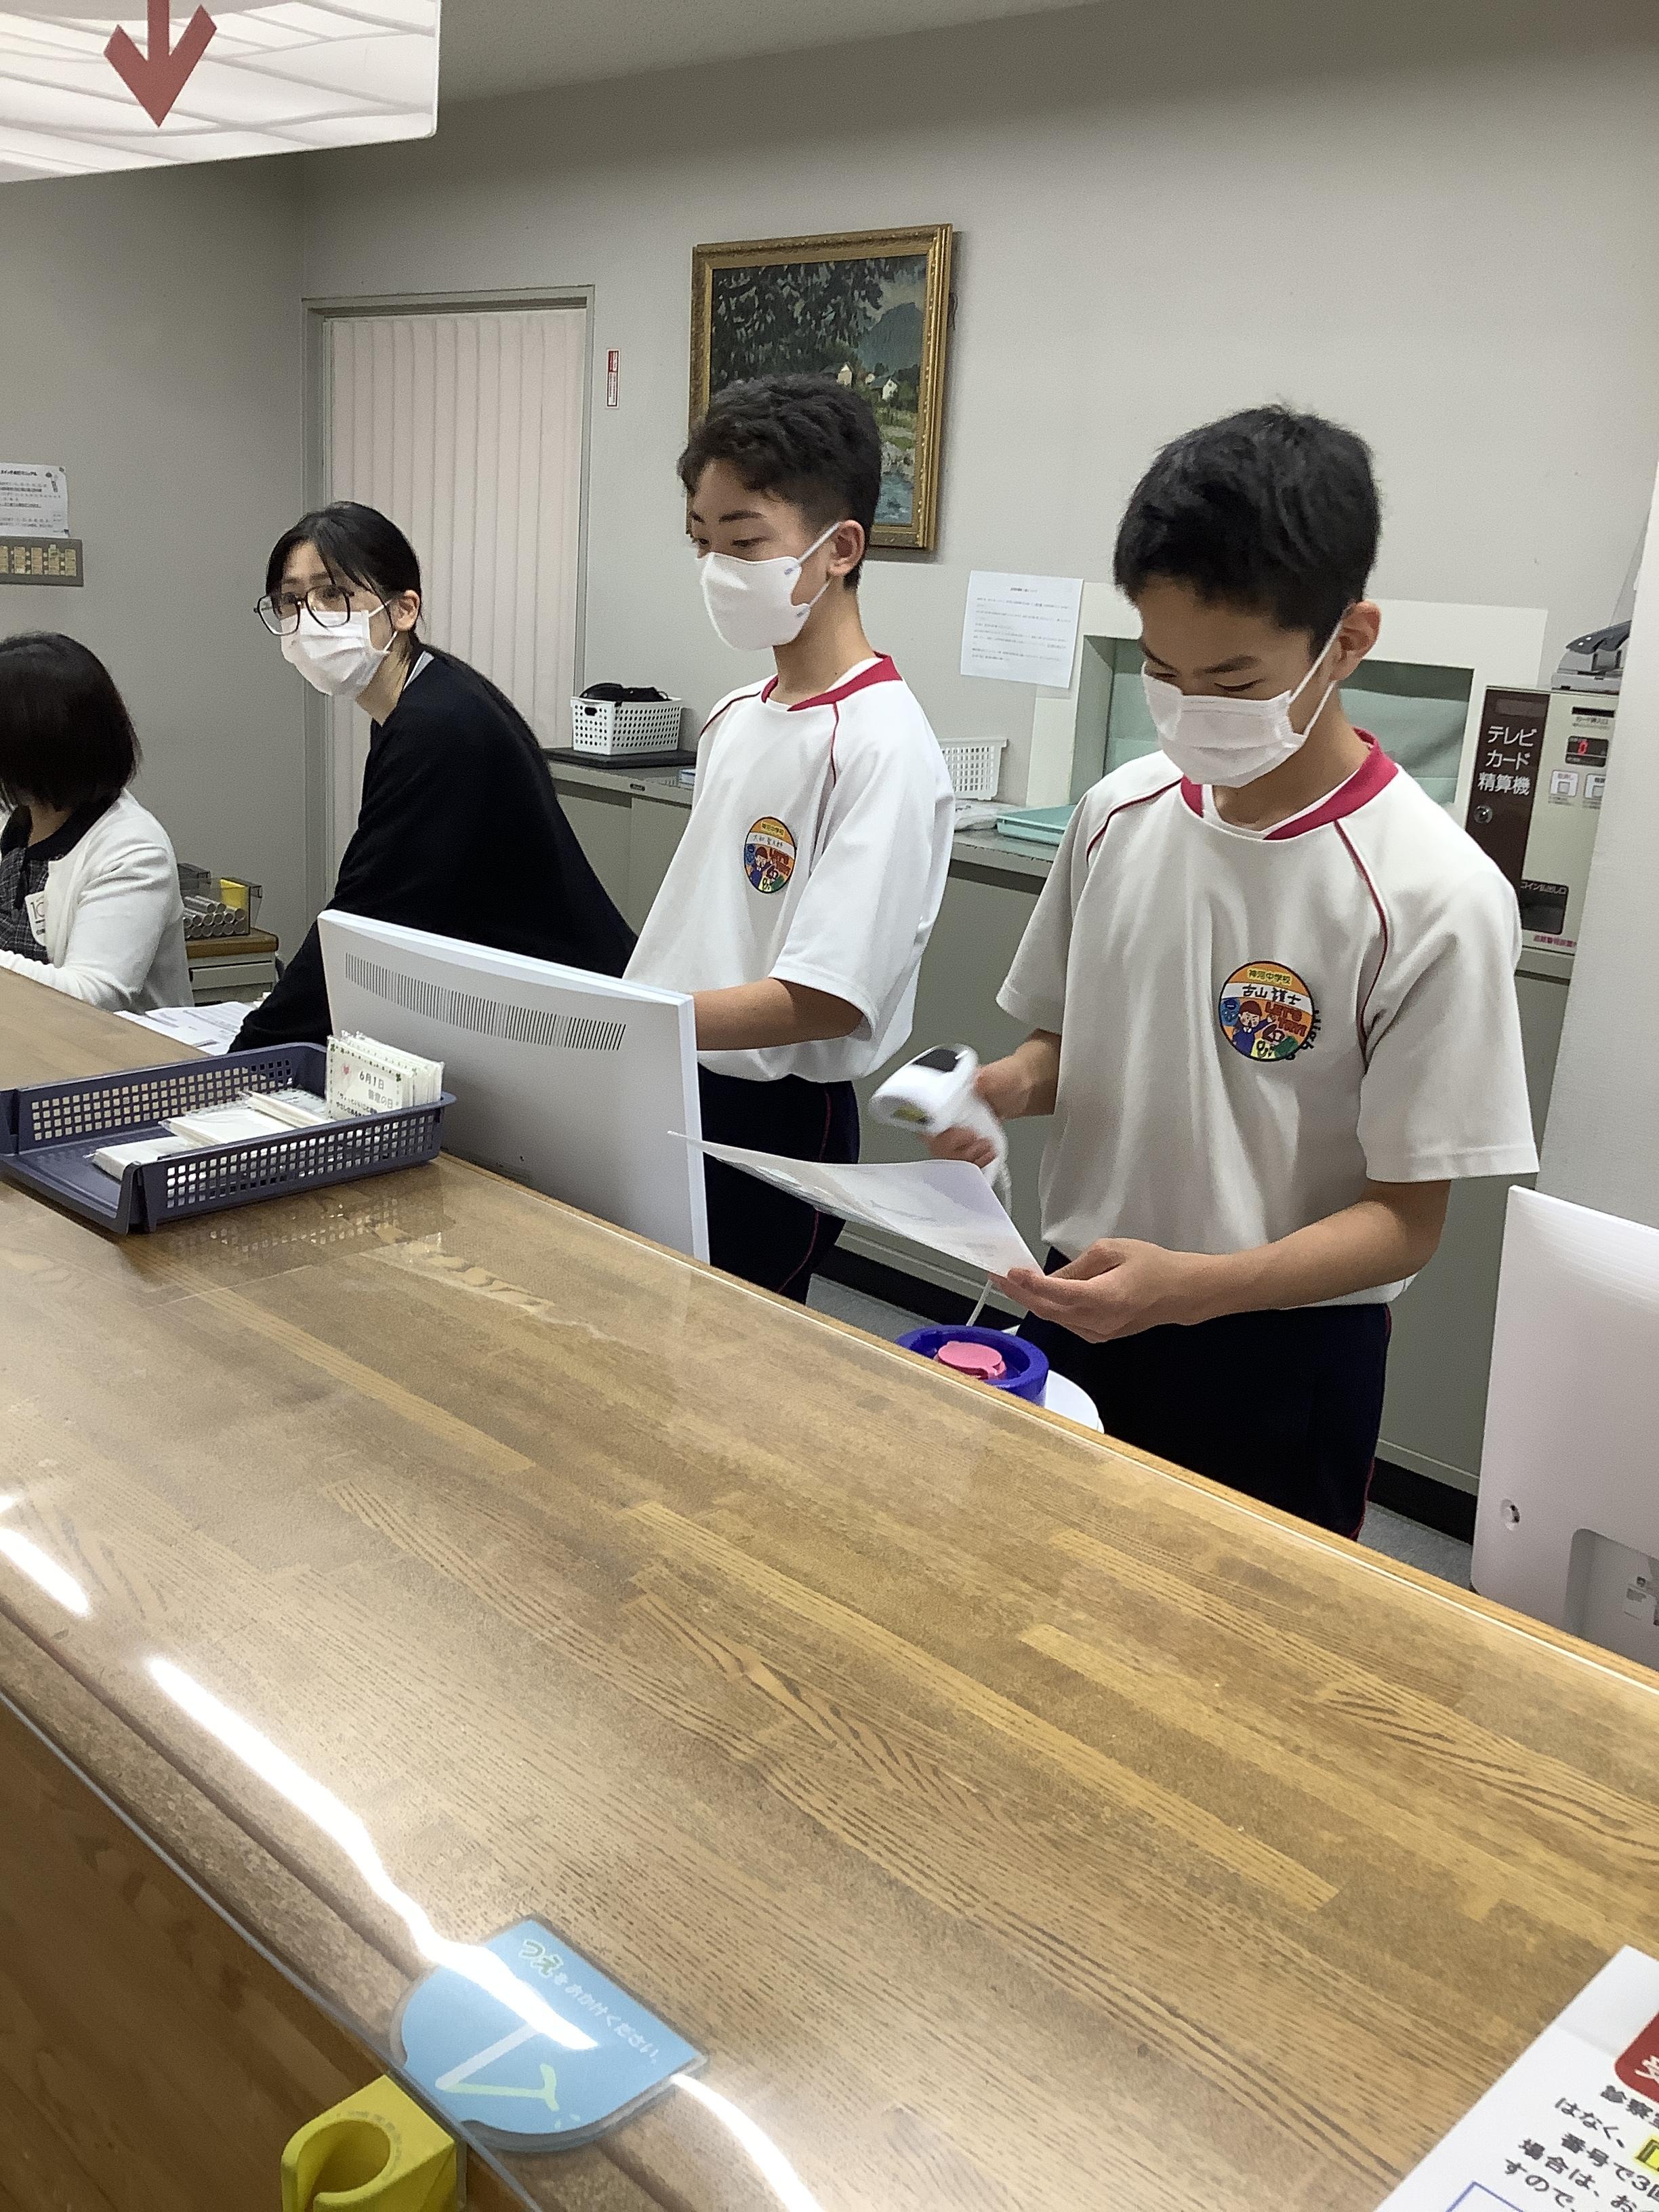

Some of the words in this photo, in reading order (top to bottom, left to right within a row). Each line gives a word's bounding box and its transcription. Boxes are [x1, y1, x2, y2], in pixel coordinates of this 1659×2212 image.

[1488, 725, 1538, 747] テレビ
[1486, 749, 1530, 770] カード
[1477, 771, 1532, 796] 精算機
[359, 1071, 384, 1090] 6月1日
[518, 1938, 659, 2064] つえをおかけください。
[1555, 2097, 1625, 2148] はなく、
